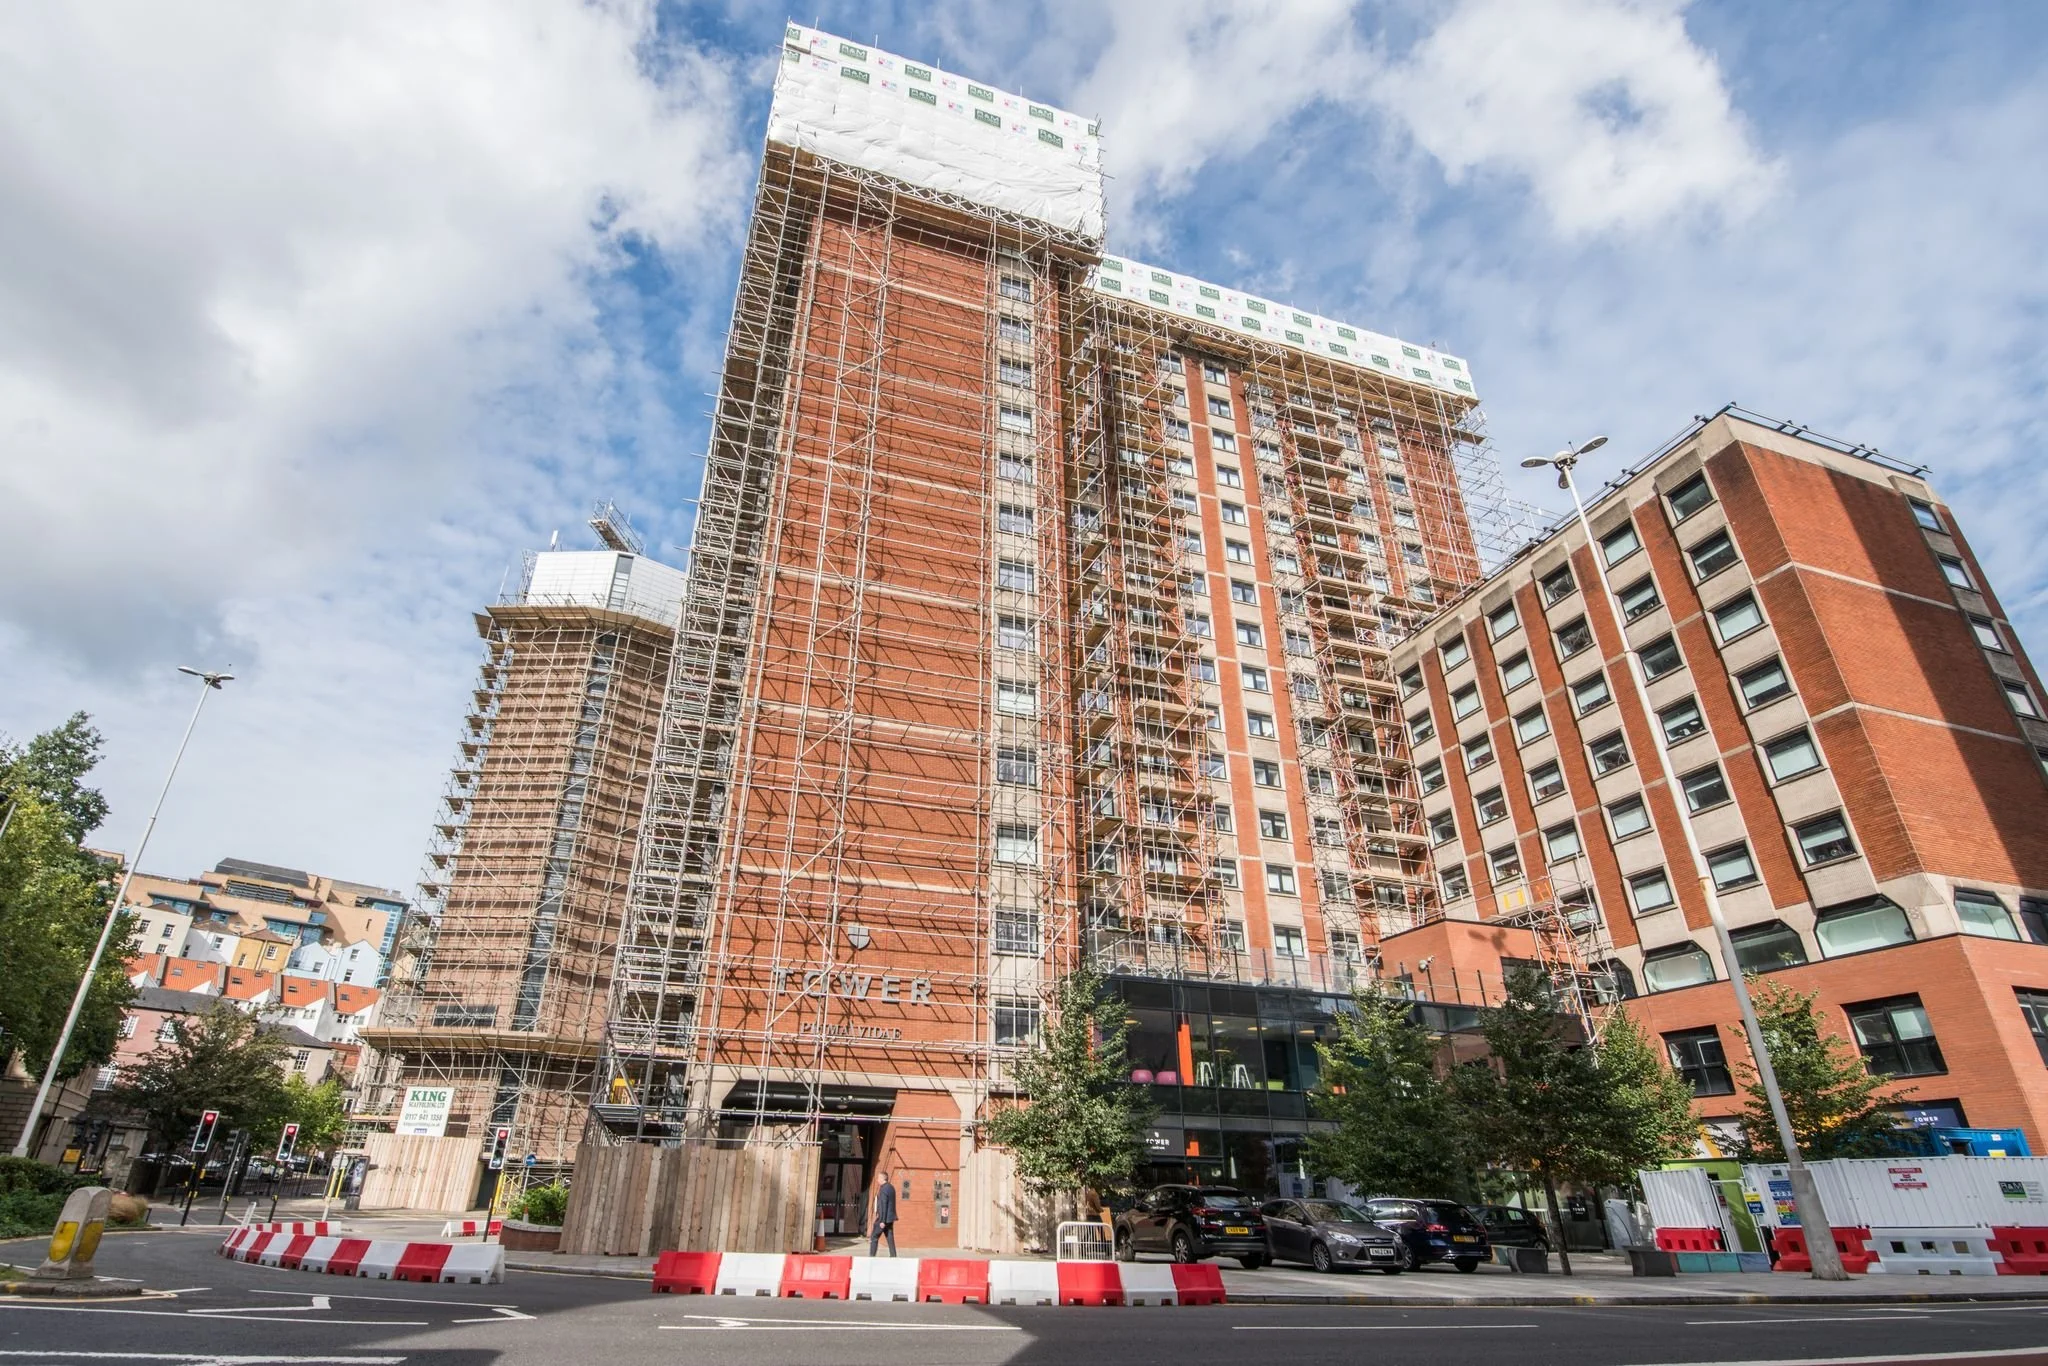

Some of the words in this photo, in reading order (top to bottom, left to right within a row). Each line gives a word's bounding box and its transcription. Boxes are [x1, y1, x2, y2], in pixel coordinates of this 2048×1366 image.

[773, 966, 932, 1006] TOWER
[411, 1090, 447, 1102] KING
[405, 1113, 417, 1121] 0117
[1145, 1138, 1170, 1146] TOWER
